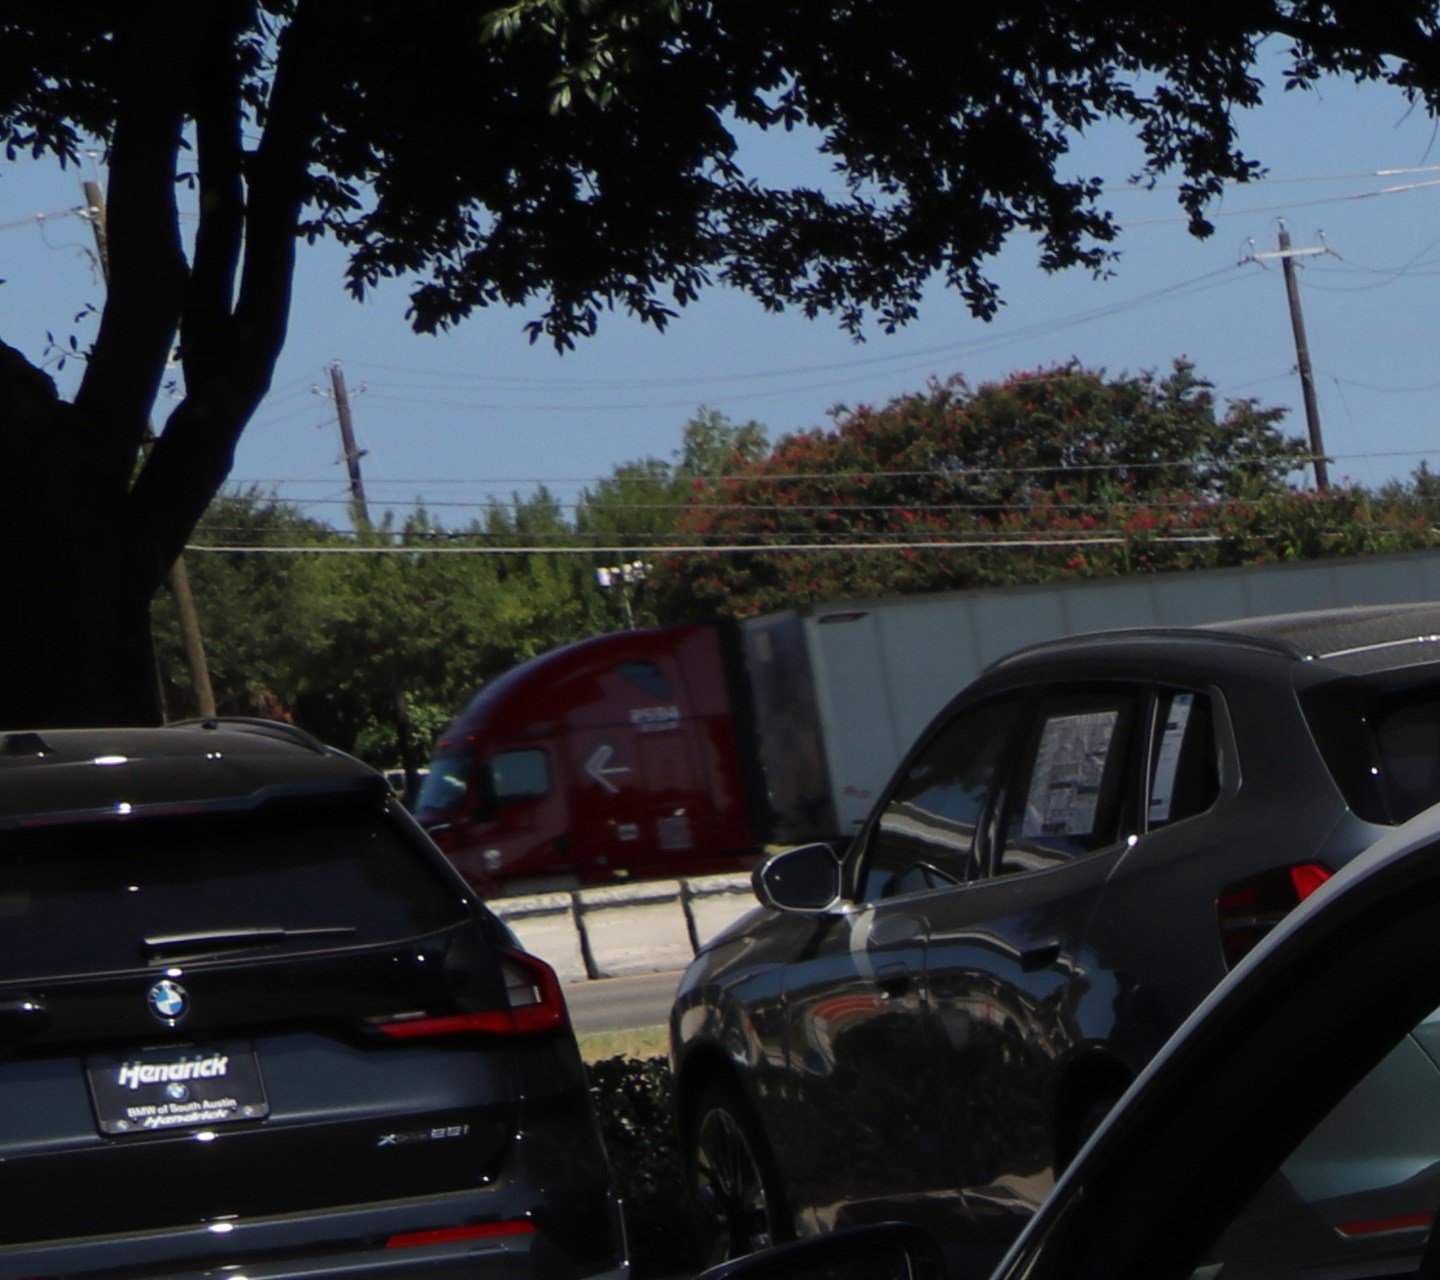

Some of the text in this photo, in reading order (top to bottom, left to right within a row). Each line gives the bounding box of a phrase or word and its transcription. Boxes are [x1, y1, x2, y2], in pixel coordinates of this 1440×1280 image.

[118, 1052, 229, 1090] Hendrick
[127, 1097, 237, 1117] BMW of South Austin
[144, 1109, 229, 1129] Hendrick
